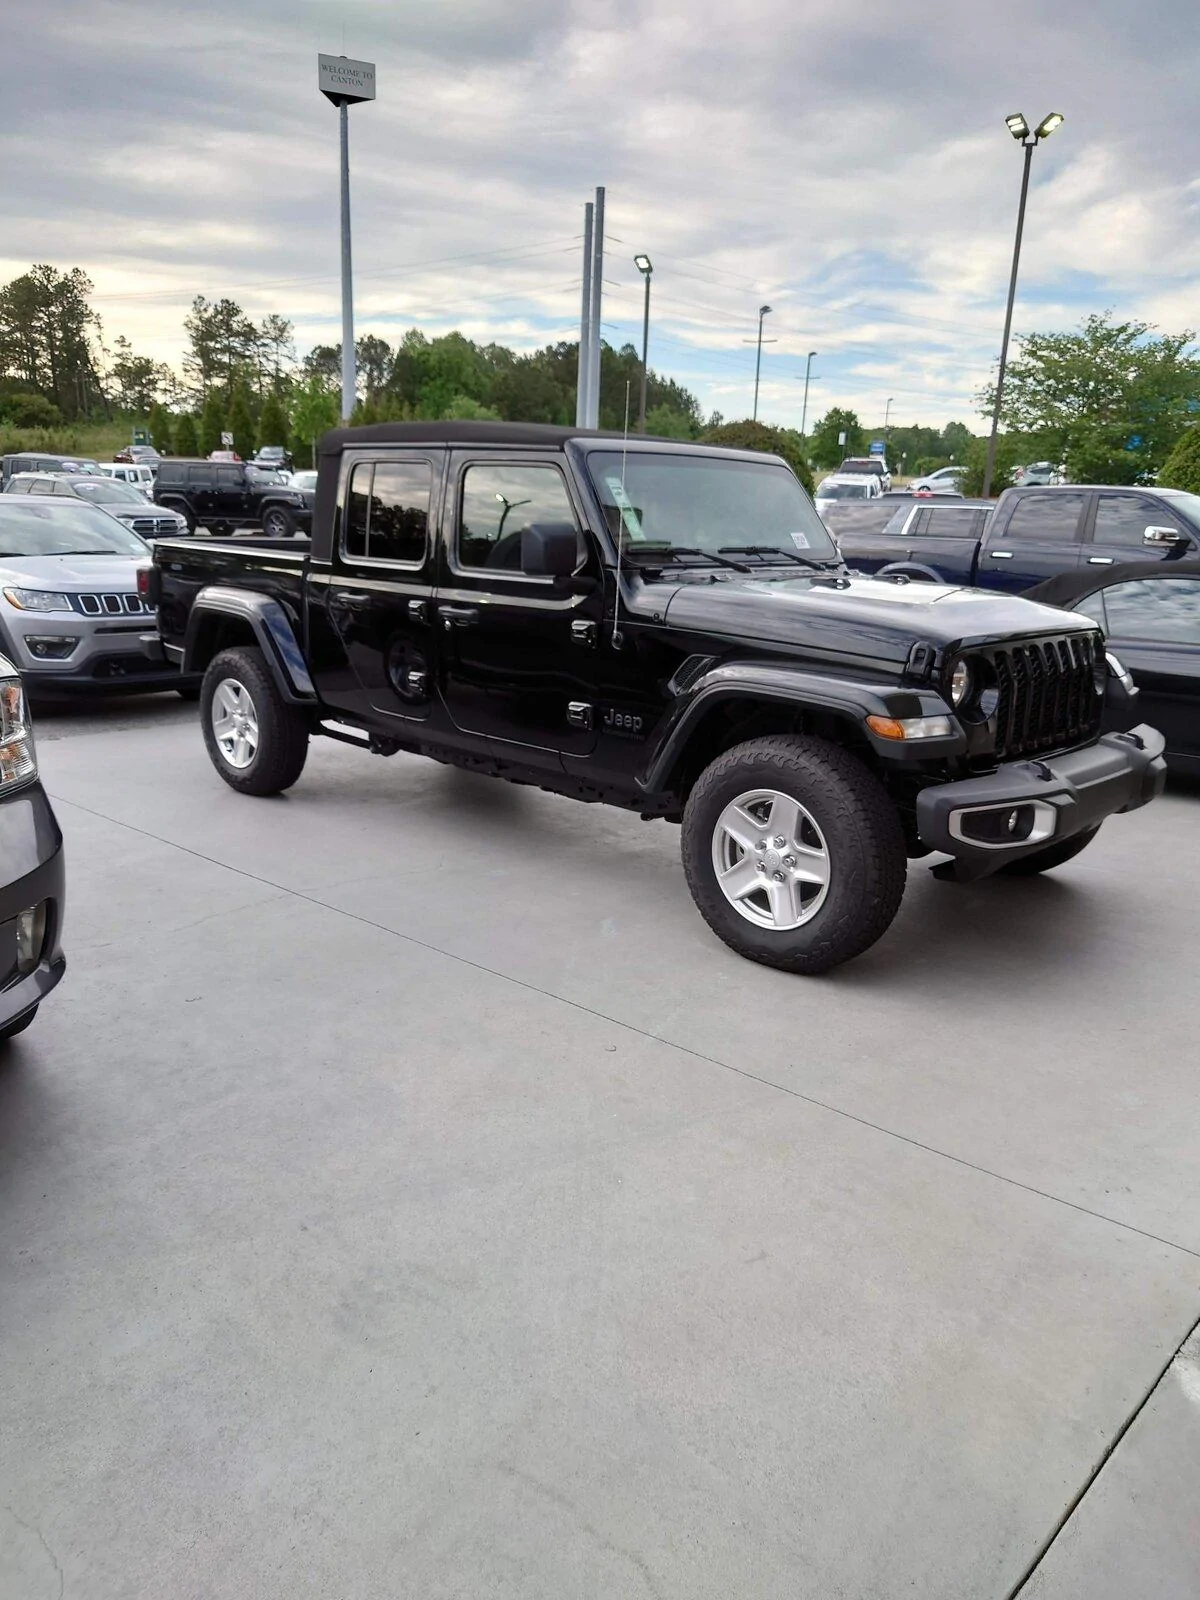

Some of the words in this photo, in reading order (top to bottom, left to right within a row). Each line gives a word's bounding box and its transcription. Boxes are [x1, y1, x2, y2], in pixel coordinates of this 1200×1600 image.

[321, 64, 359, 77] WELCOME
[362, 71, 373, 80] TO
[331, 74, 363, 87] CANTON
[604, 708, 643, 733] Jeep
